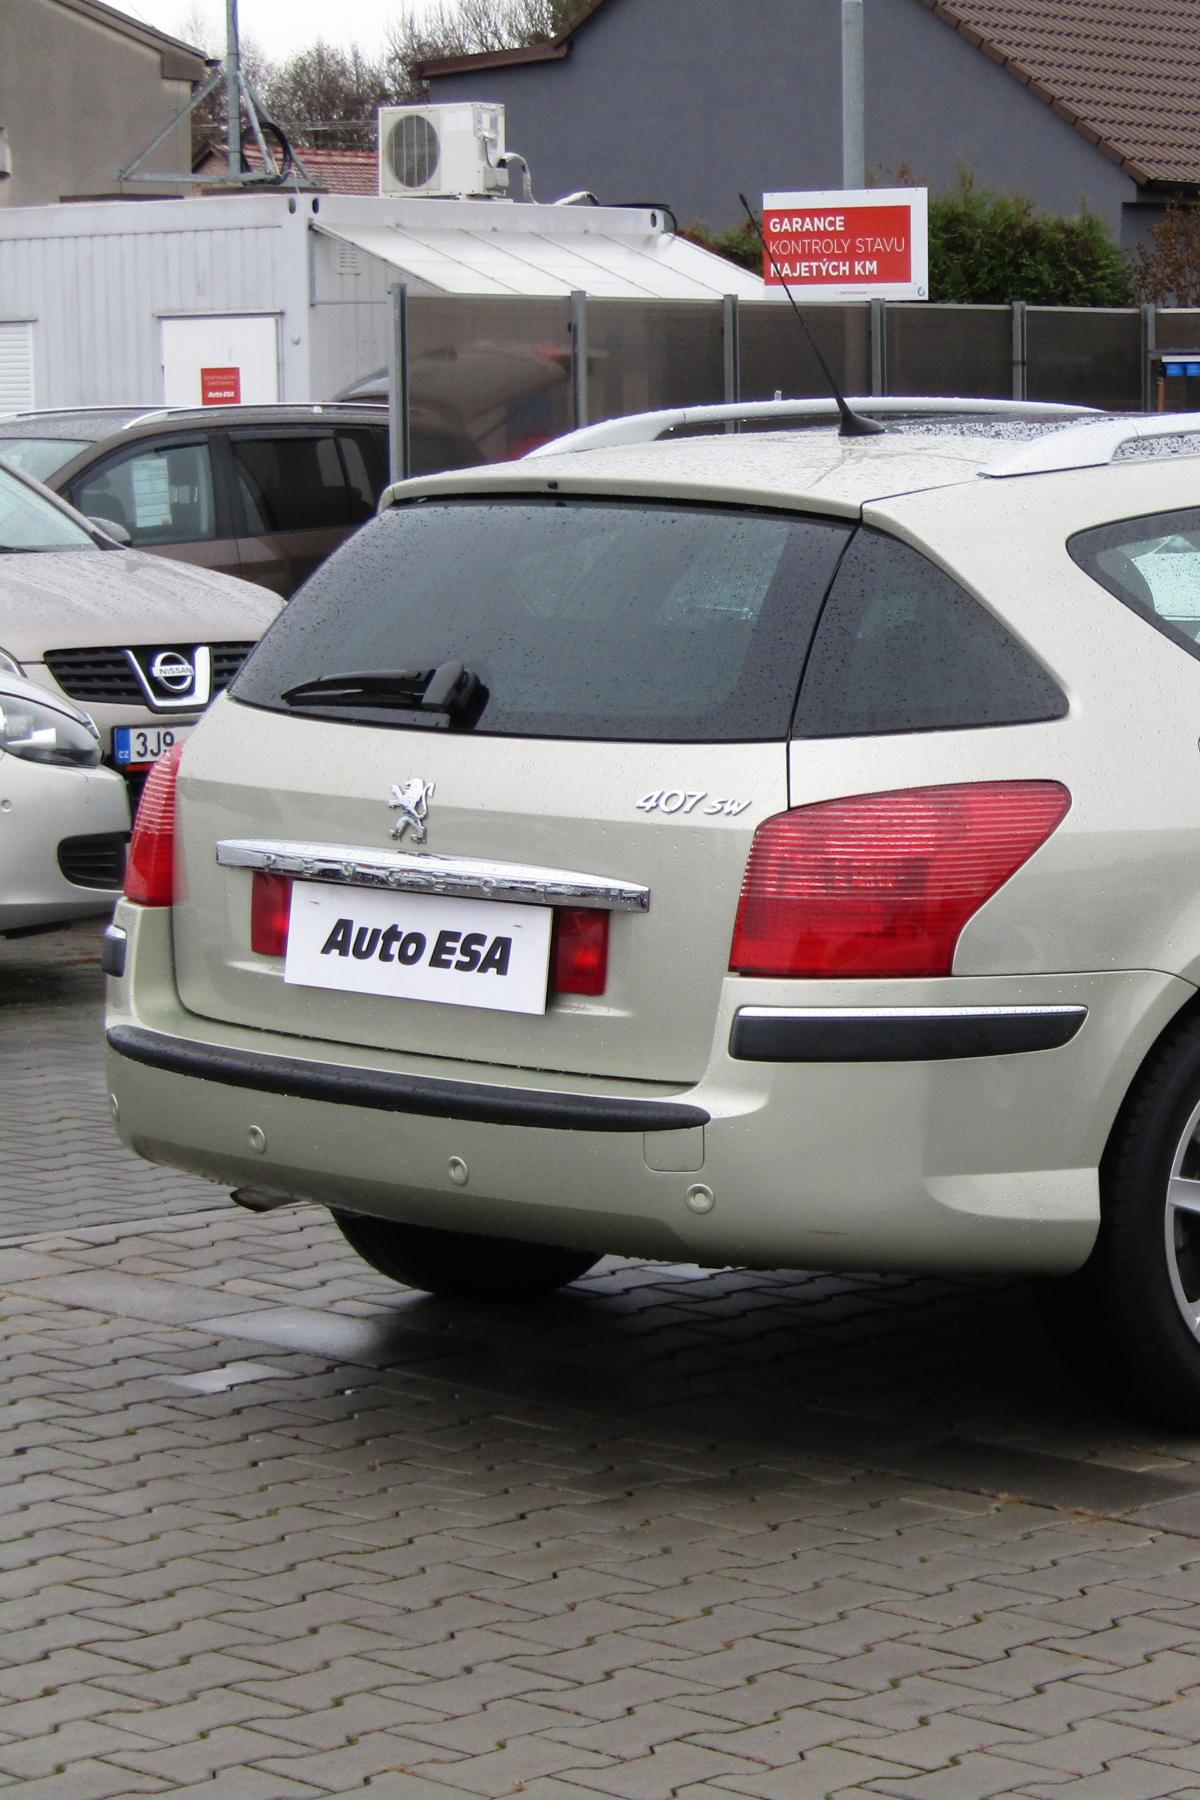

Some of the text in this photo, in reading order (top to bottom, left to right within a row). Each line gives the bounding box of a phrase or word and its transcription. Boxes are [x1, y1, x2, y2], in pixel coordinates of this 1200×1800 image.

[769, 216, 845, 233] GARANCE
[769, 237, 905, 256] KONTROLY STAVU
[769, 258, 878, 277] NAJETÝCH KM
[159, 666, 193, 676] NISSAN
[118, 750, 129, 759] CZ
[635, 789, 708, 815] 407
[320, 918, 513, 977] Auto ESA
